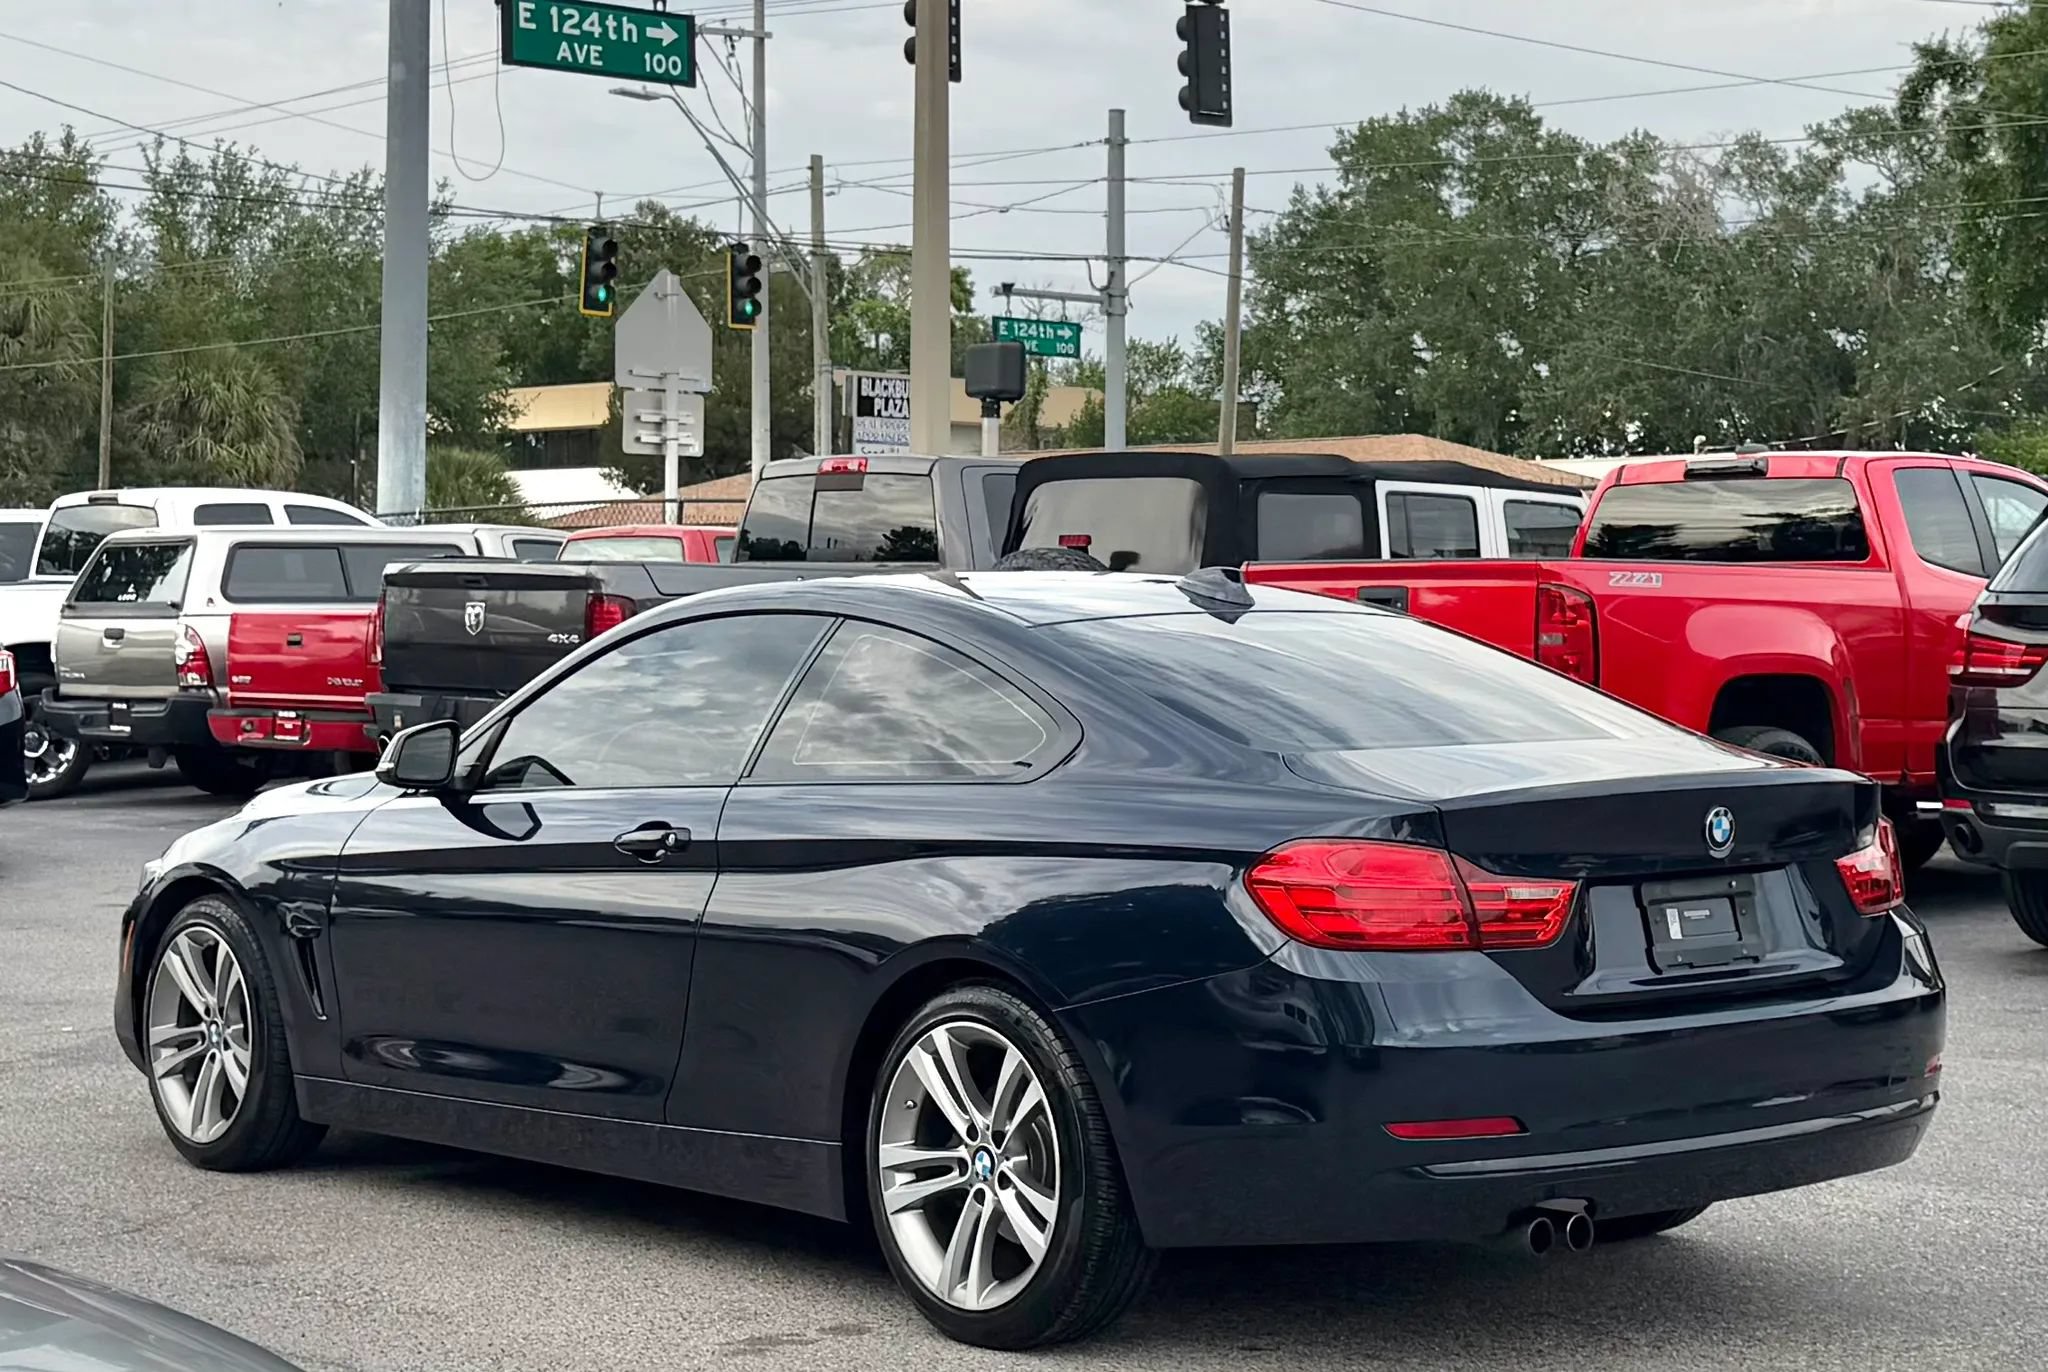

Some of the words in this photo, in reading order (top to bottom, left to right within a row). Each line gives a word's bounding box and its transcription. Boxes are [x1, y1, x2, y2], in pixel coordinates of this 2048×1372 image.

[518, 2, 537, 30] E
[550, 6, 638, 43] 124th
[556, 41, 603, 66] AVE
[644, 52, 682, 76] 100
[999, 321, 1008, 335] E
[1013, 321, 1054, 339] 124th
[1022, 339, 1039, 352] VE
[1056, 342, 1075, 354] 100
[861, 377, 910, 399] BLACKBU
[874, 397, 909, 418] PLAZA
